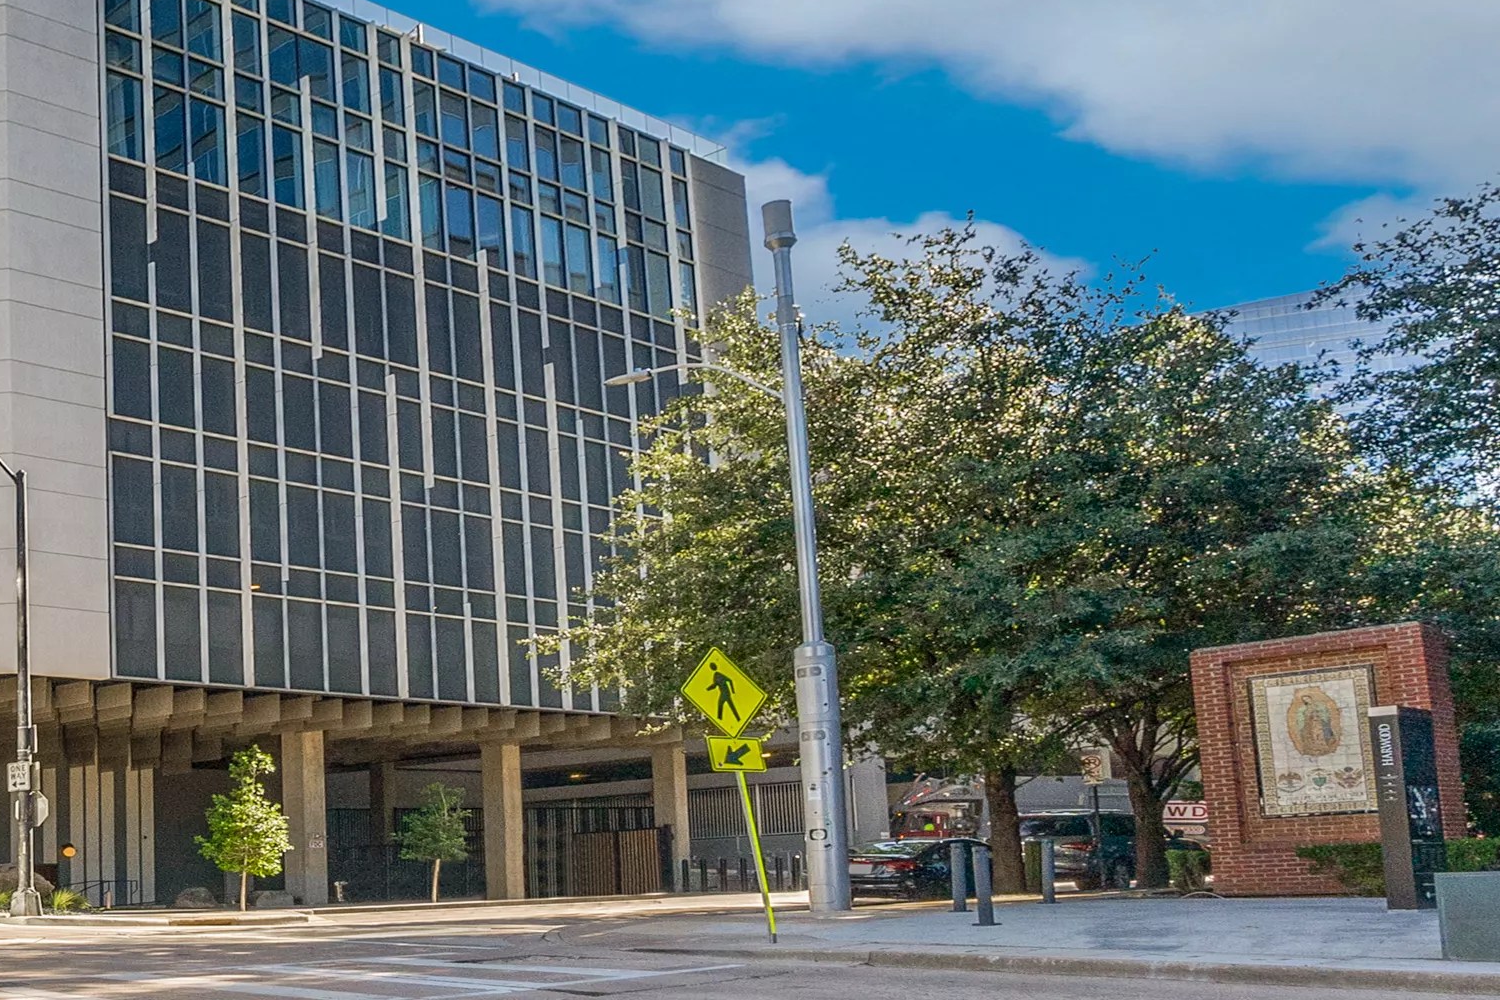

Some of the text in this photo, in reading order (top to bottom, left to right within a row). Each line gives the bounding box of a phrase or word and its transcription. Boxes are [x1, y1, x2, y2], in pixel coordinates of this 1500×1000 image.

[1378, 723, 1395, 767] HARWOOD
[10, 764, 26, 773] ONE
[10, 772, 27, 780] WAY
